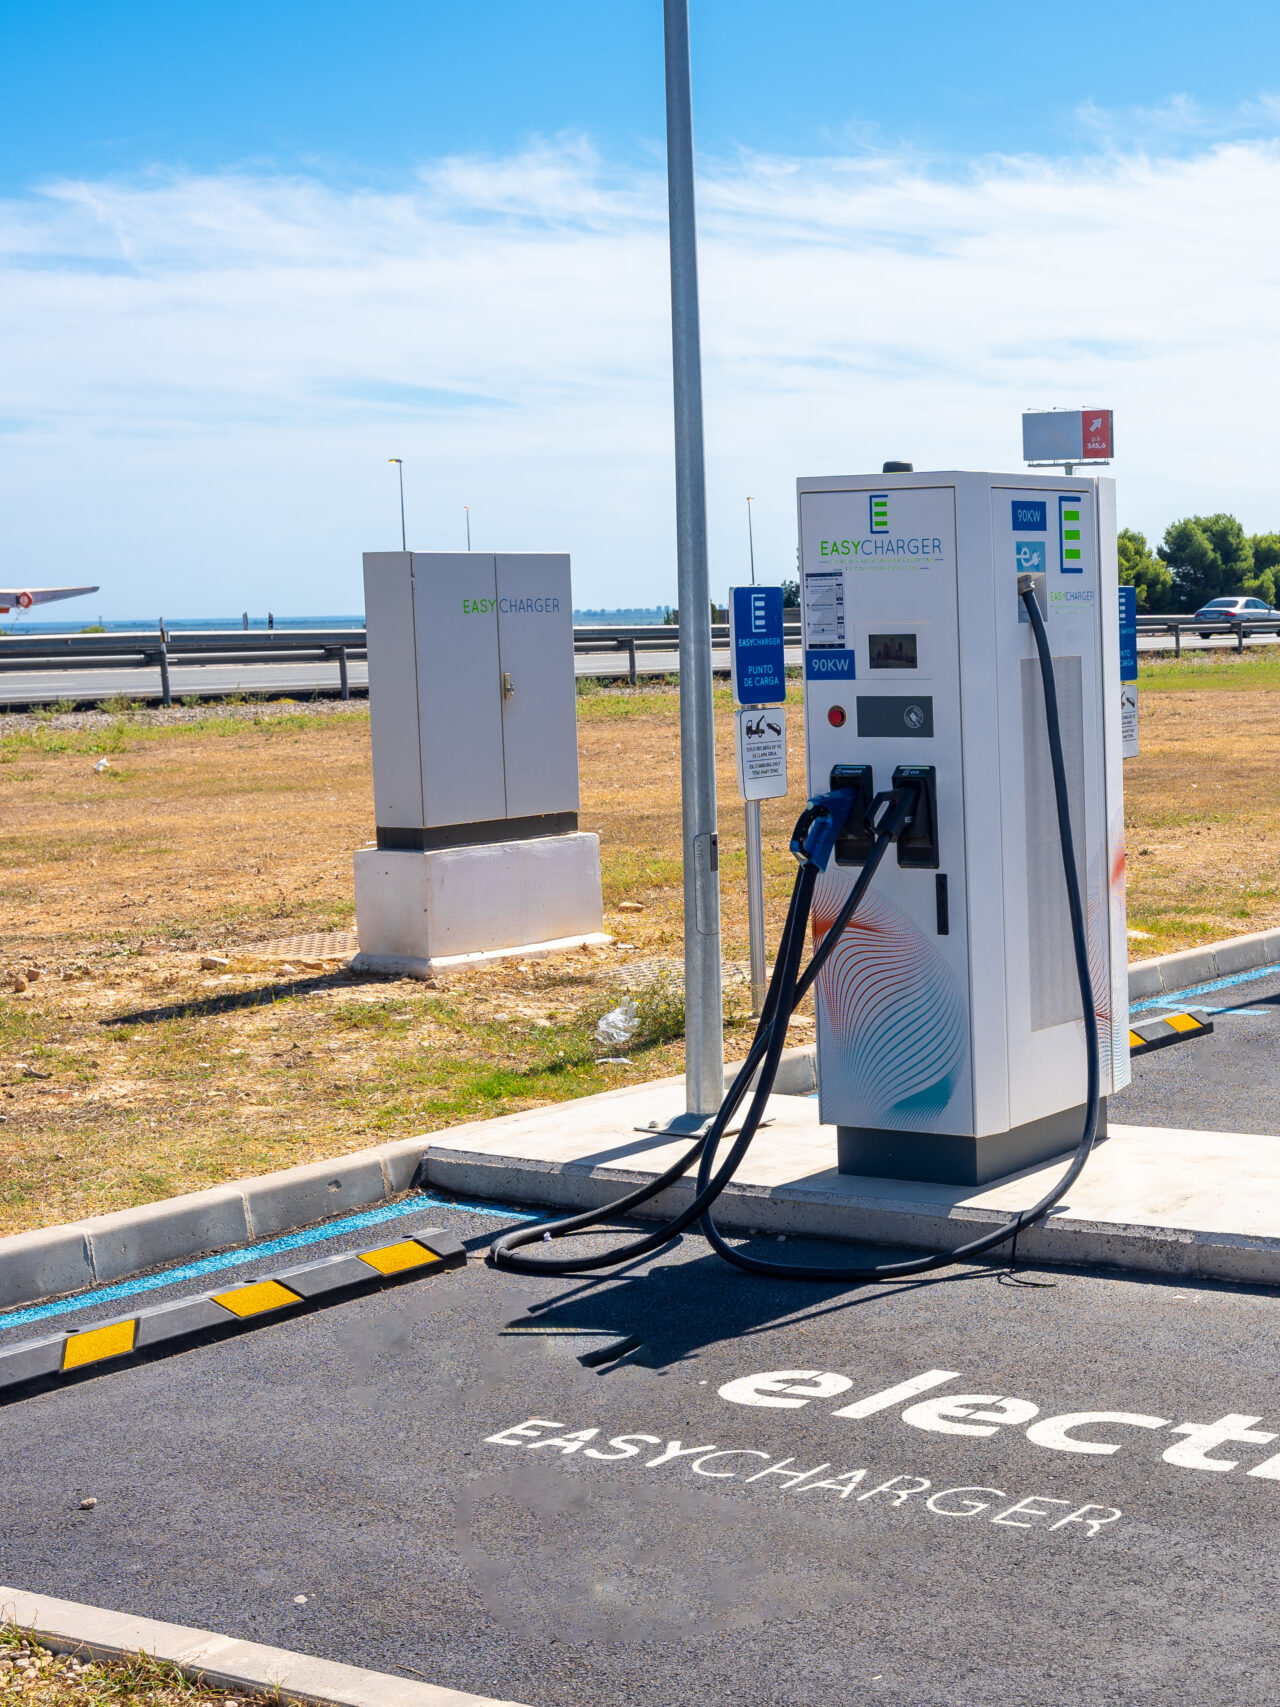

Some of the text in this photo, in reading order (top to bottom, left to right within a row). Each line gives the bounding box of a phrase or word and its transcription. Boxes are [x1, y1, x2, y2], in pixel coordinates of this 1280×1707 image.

[1017, 509, 1041, 523] 90KW
[820, 538, 942, 556] EASYCHARGER
[1050, 591, 1094, 601] EASYCHARGER
[738, 638, 781, 647] EASYCHARGER
[748, 664, 774, 675] PUNTO
[812, 658, 849, 672] 90KW
[744, 675, 779, 687] DE CARGA
[484, 1419, 1124, 1537] EASYCHARGER
